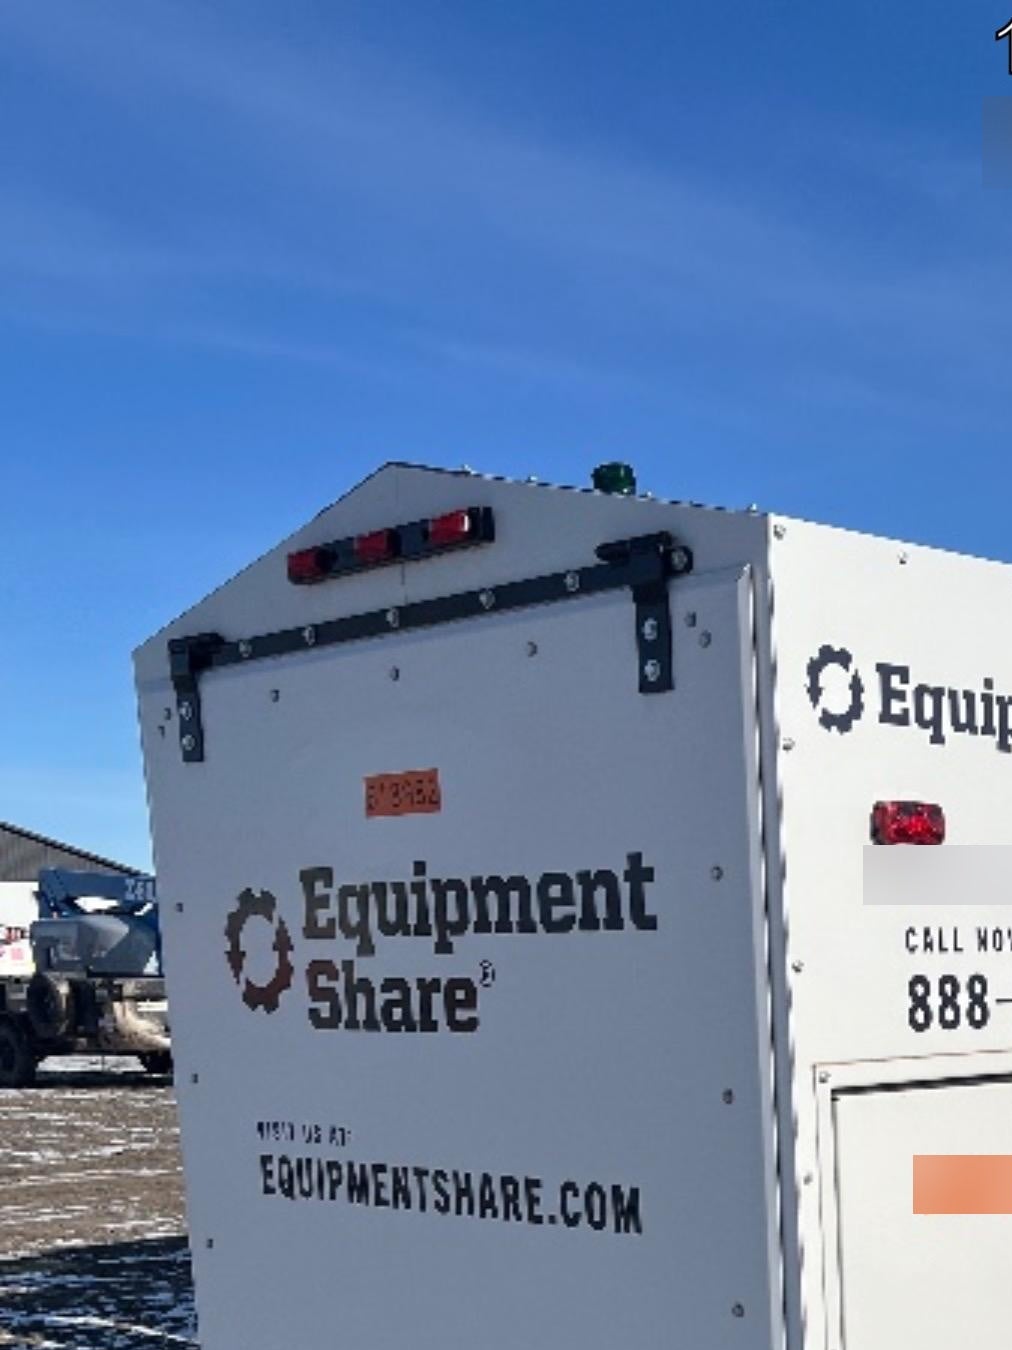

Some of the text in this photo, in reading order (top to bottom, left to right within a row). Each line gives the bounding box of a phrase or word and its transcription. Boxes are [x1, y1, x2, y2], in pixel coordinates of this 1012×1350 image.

[299, 851, 658, 956] Equipment
[904, 925, 965, 955] CALL
[258, 1153, 644, 1235] EQUIPMENTSHARE.COM
